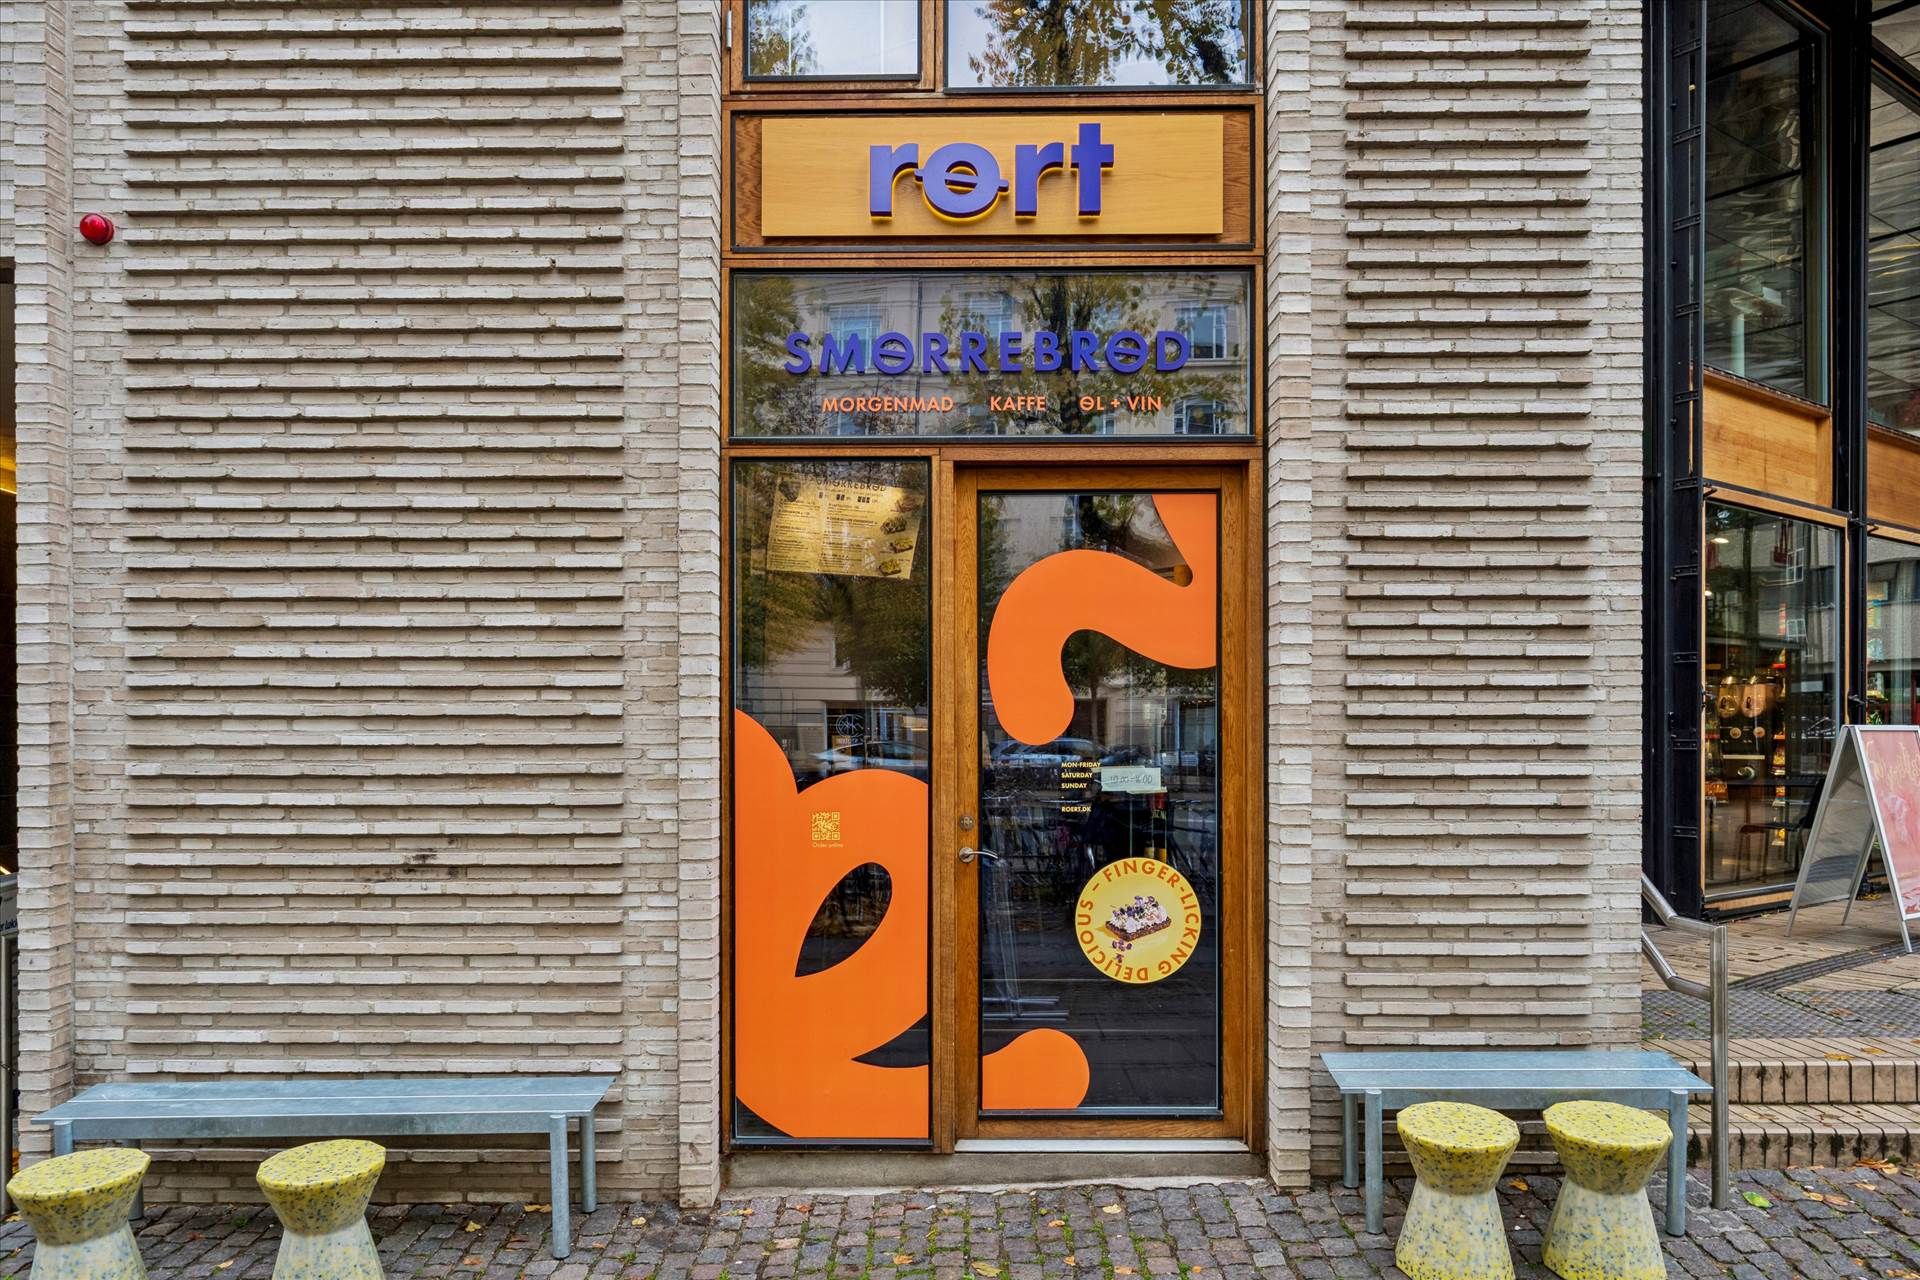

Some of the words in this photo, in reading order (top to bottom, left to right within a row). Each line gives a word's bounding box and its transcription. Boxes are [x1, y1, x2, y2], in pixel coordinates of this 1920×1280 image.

[784, 330, 1191, 375] SMØRREBRØD
[822, 396, 954, 413] MORGENMAD
[989, 396, 1046, 412] KAFFE
[1126, 395, 1161, 412] VIN
[1061, 761, 1101, 769] MON-FRIDAY
[1061, 805, 1092, 813] ROERT.DK
[1077, 899, 1149, 981] DELICIOUS
